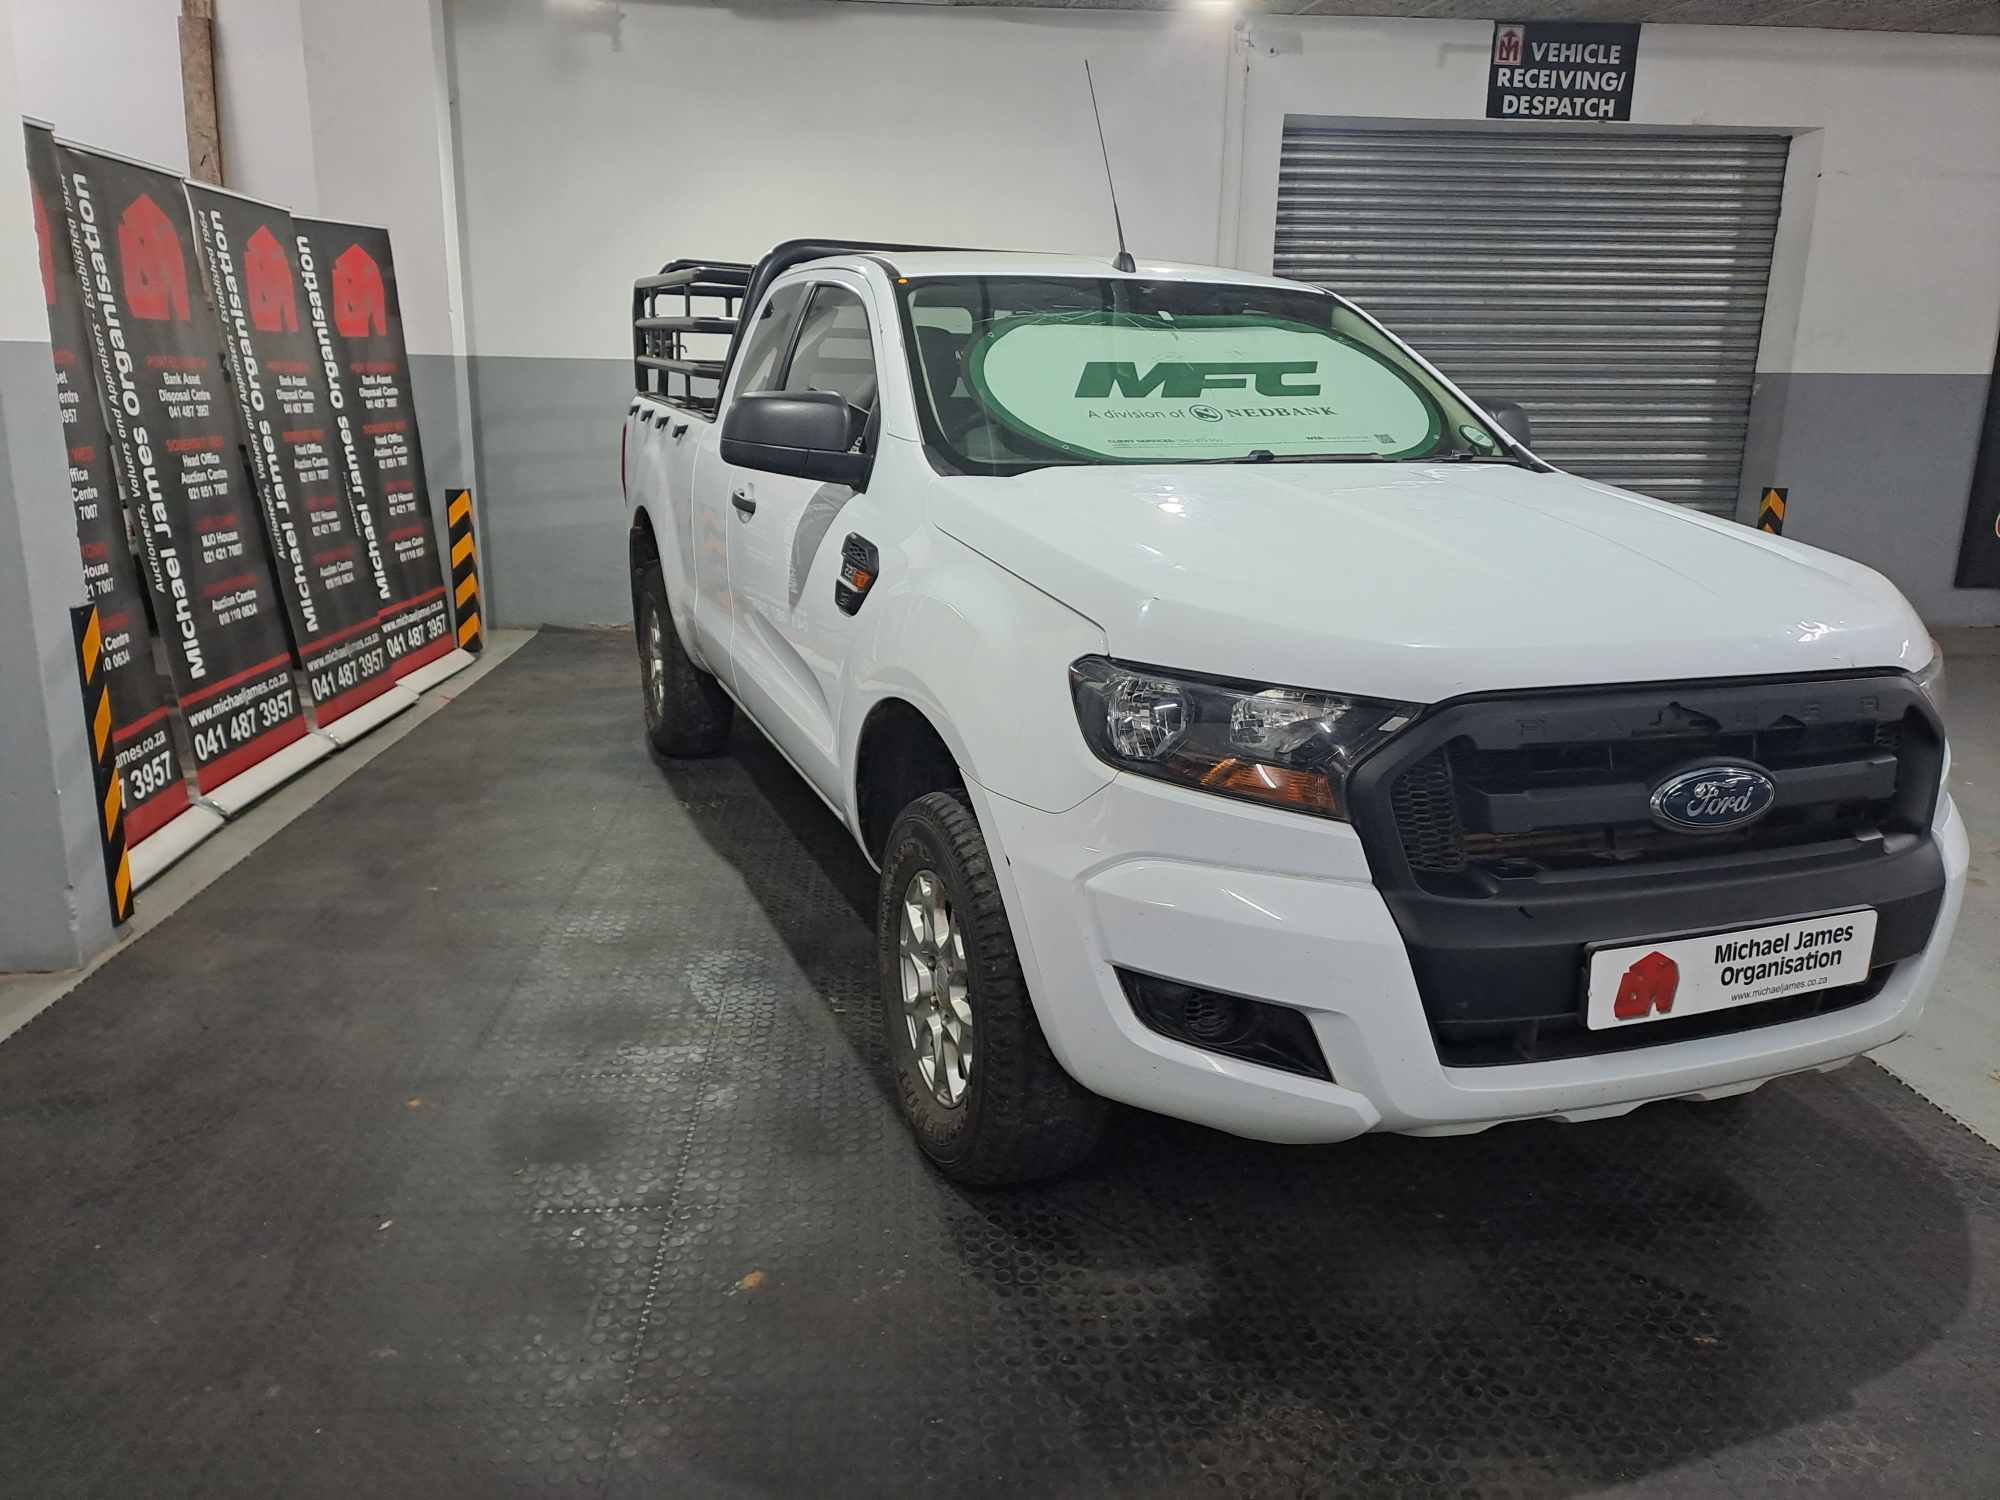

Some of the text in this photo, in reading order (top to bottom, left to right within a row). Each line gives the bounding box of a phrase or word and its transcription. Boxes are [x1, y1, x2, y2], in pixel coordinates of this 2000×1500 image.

[1531, 42, 1622, 65] VEHICLE
[1496, 67, 1627, 92] RECEIVING/
[1502, 94, 1616, 118] DESPATCH
[72, 172, 140, 417] Organisation
[210, 209, 265, 412] Organisation
[296, 235, 344, 409] Organisation
[58, 389, 80, 404] entre
[1075, 361, 1321, 398] MFC
[110, 407, 127, 439] and
[1088, 409, 1101, 419] A
[1104, 405, 1165, 420] division
[1168, 404, 1187, 419] of
[1225, 405, 1339, 418] NEDBANK
[69, 467, 89, 482] ffice
[121, 441, 141, 498] Valuers
[259, 420, 291, 514] James
[337, 415, 365, 498] James
[132, 426, 172, 538] James
[356, 502, 392, 600] Michael
[281, 521, 319, 633] Michael
[160, 547, 206, 680] Michael
[386, 613, 446, 659] 041 487 3957
[311, 647, 384, 701] 041 487 3957
[193, 689, 294, 761] 041 487 3957
[114, 729, 167, 769] ames.co.za
[130, 749, 172, 800] 3957
[1686, 782, 1755, 817] Ford
[1714, 923, 1854, 964] Michael James
[1720, 948, 1842, 987] Organisation
[1730, 974, 1828, 1001] www.michaeljames.co.za
